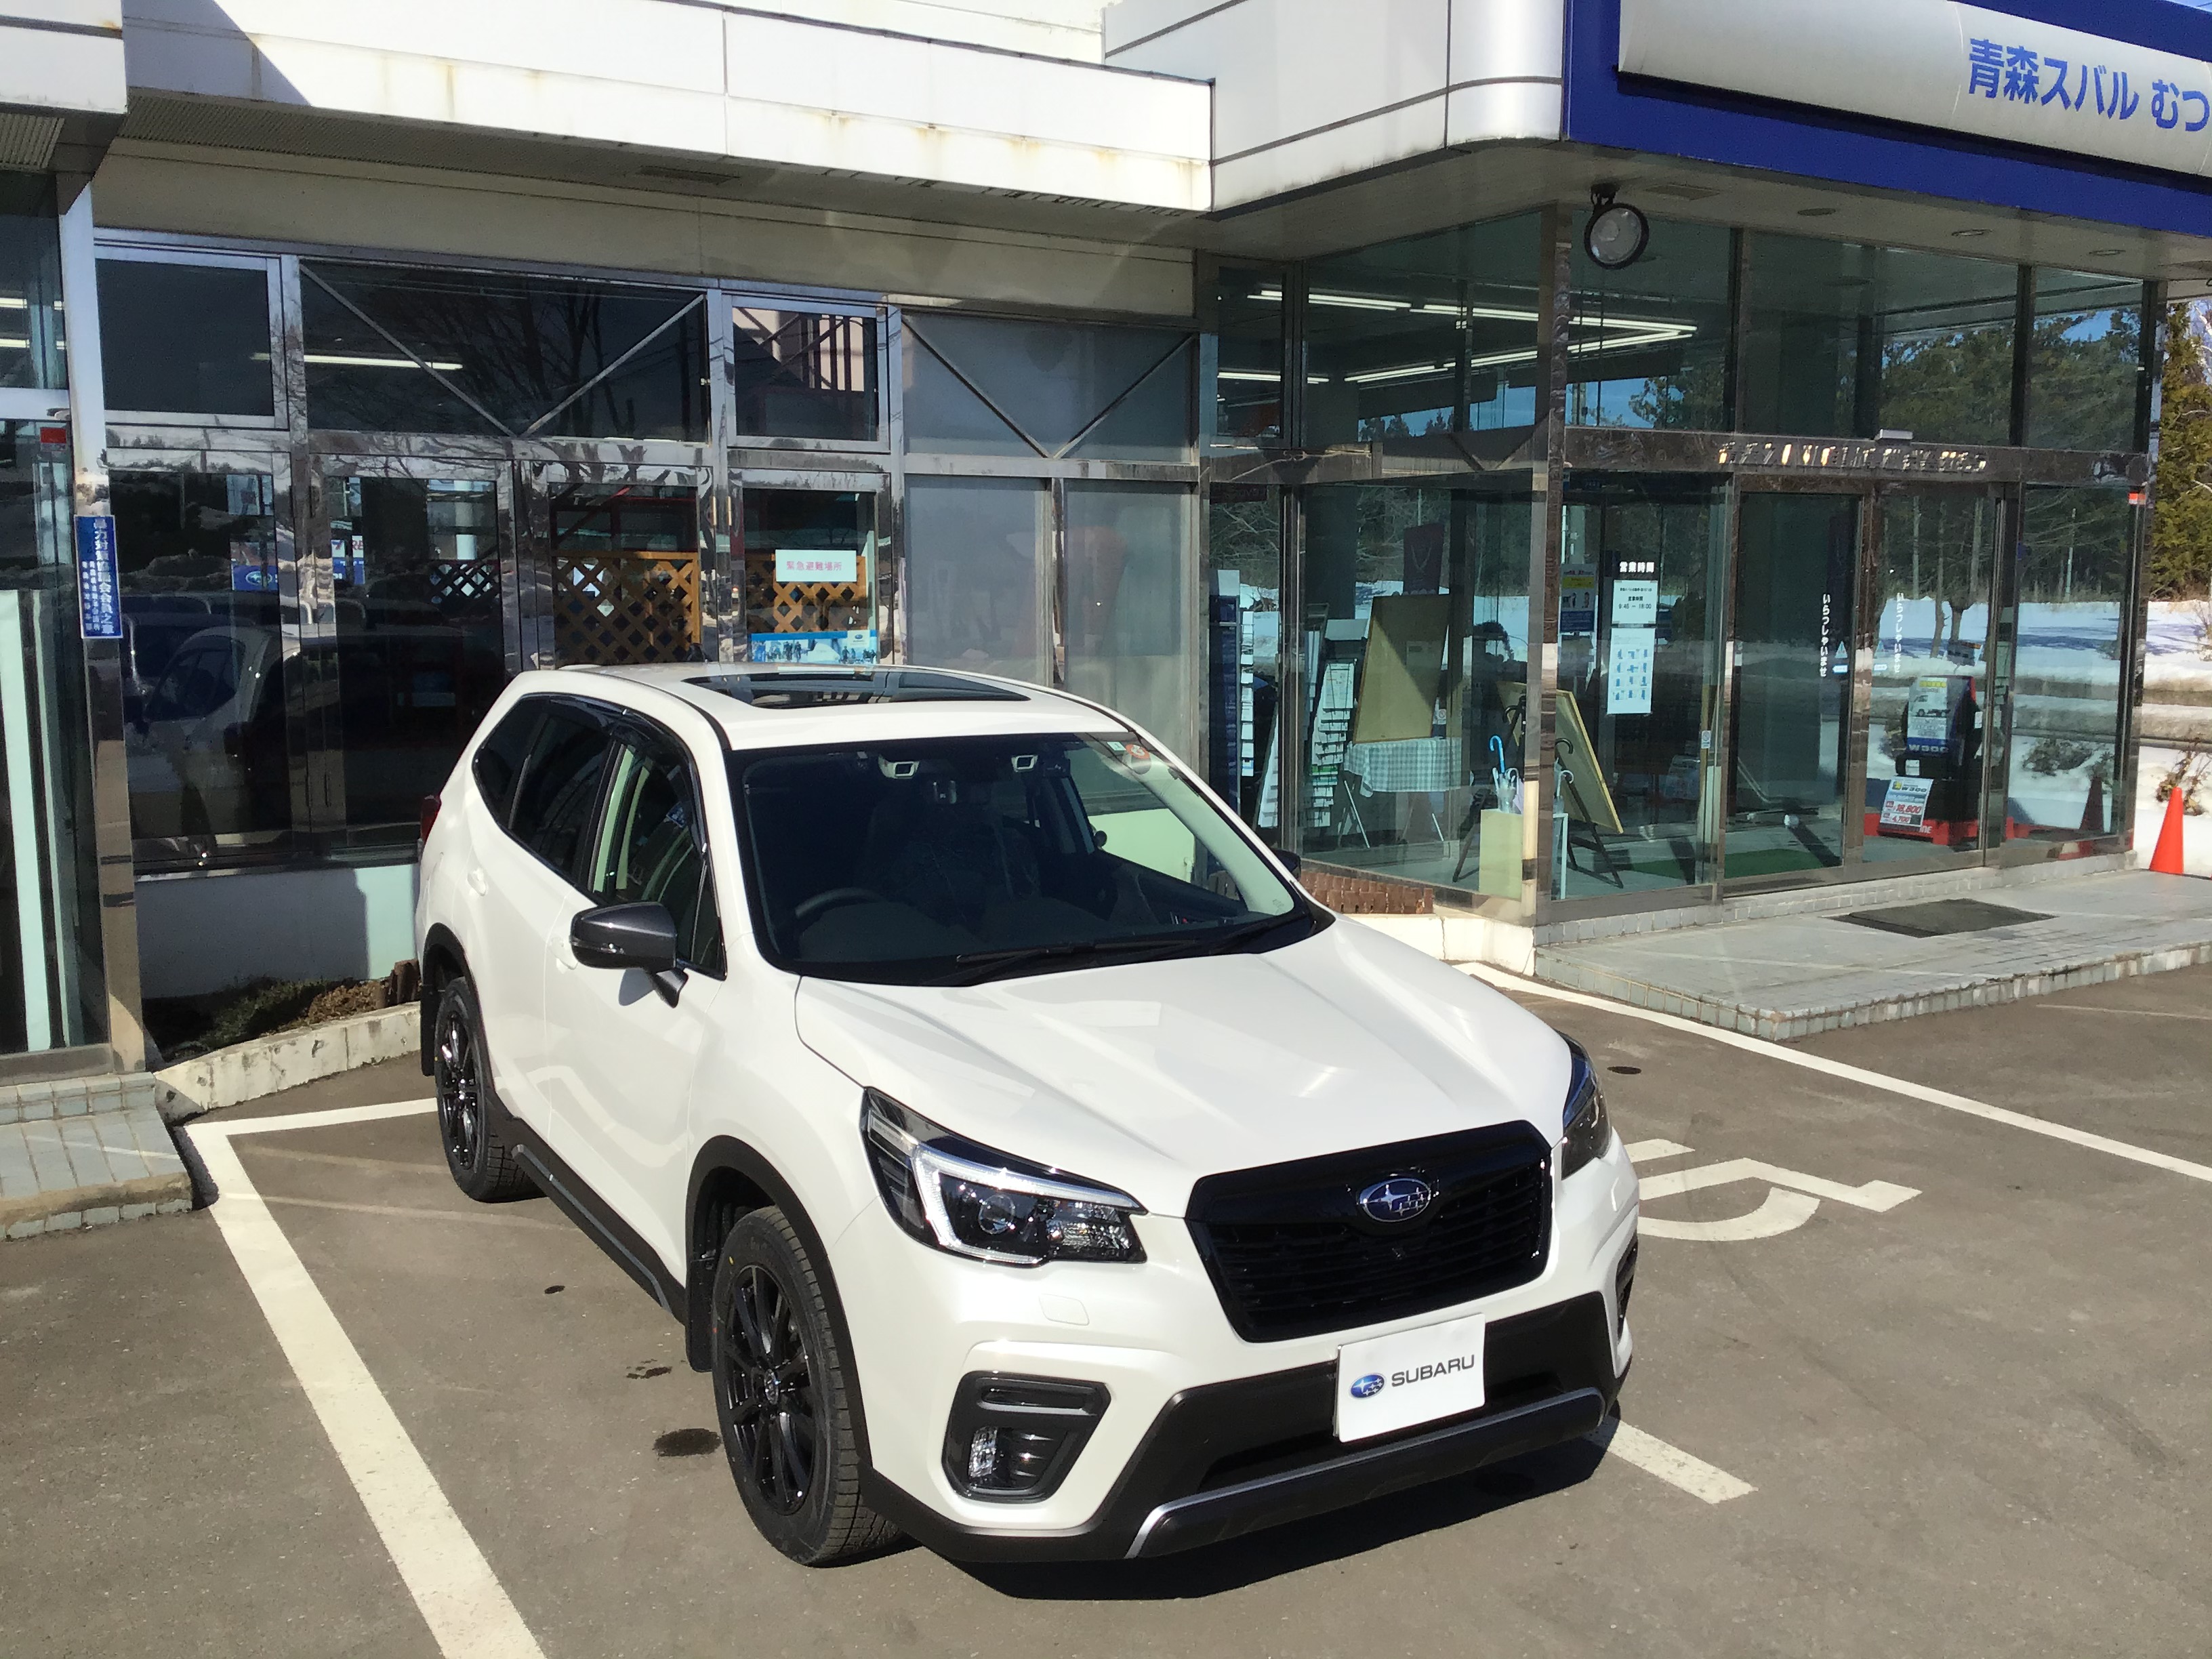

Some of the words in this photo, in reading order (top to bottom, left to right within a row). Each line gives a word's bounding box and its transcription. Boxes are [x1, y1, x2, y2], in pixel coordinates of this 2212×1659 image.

[1969, 39, 2139, 120] 青森スバル
[2152, 79, 2210, 131] むつ
[786, 560, 842, 571] 緊急避難場所
[1620, 561, 1654, 573] 営業時間
[1391, 1354, 1475, 1387] SUBARU
